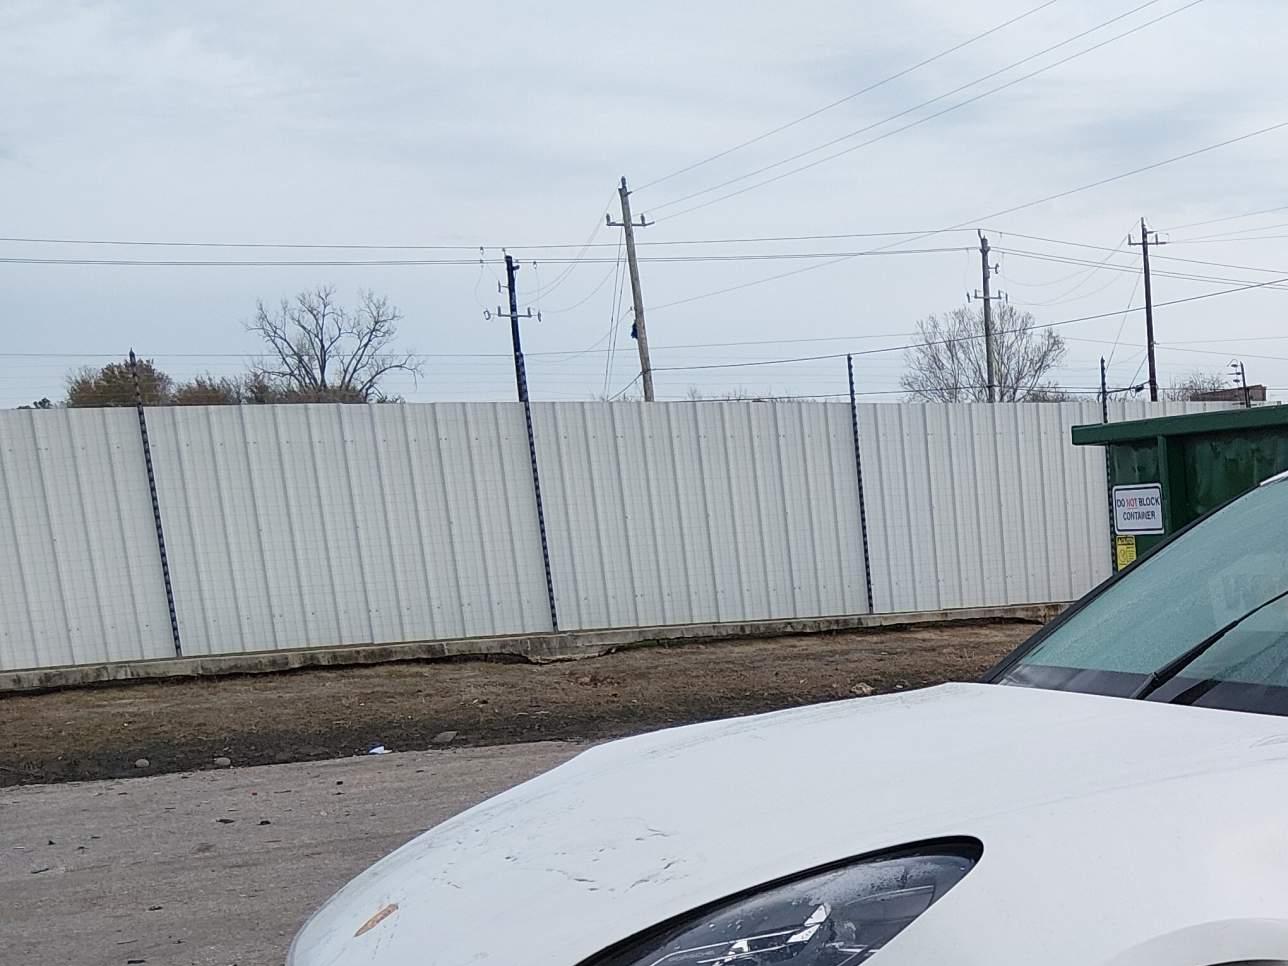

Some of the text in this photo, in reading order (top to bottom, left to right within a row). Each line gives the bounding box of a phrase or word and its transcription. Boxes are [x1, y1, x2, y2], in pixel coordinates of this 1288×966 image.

[1116, 496, 1160, 509] DO NOT BLOCK
[1123, 510, 1156, 520] CONTAINER
